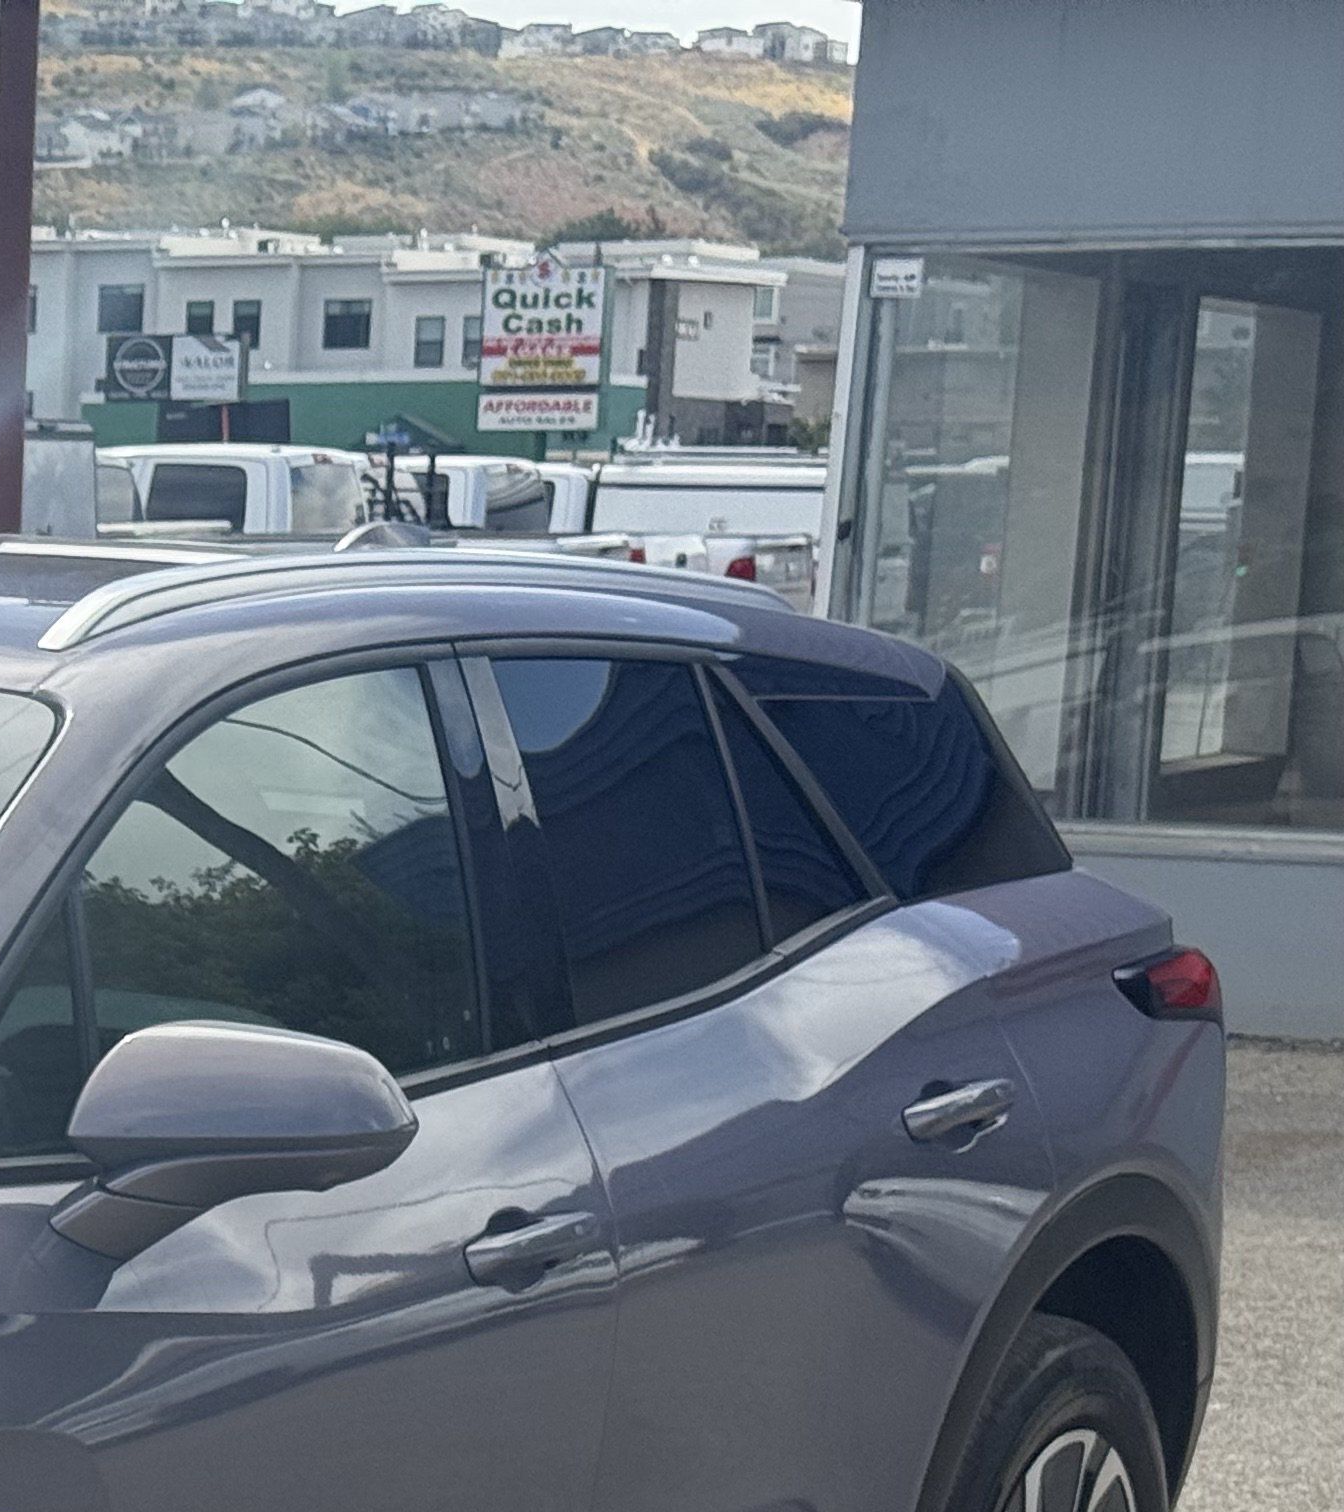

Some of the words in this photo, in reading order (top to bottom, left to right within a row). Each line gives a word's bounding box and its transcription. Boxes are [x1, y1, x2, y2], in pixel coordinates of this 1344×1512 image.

[492, 287, 596, 310] Quick
[502, 313, 584, 334] Cash
[483, 399, 593, 414] AFFORDABLE
